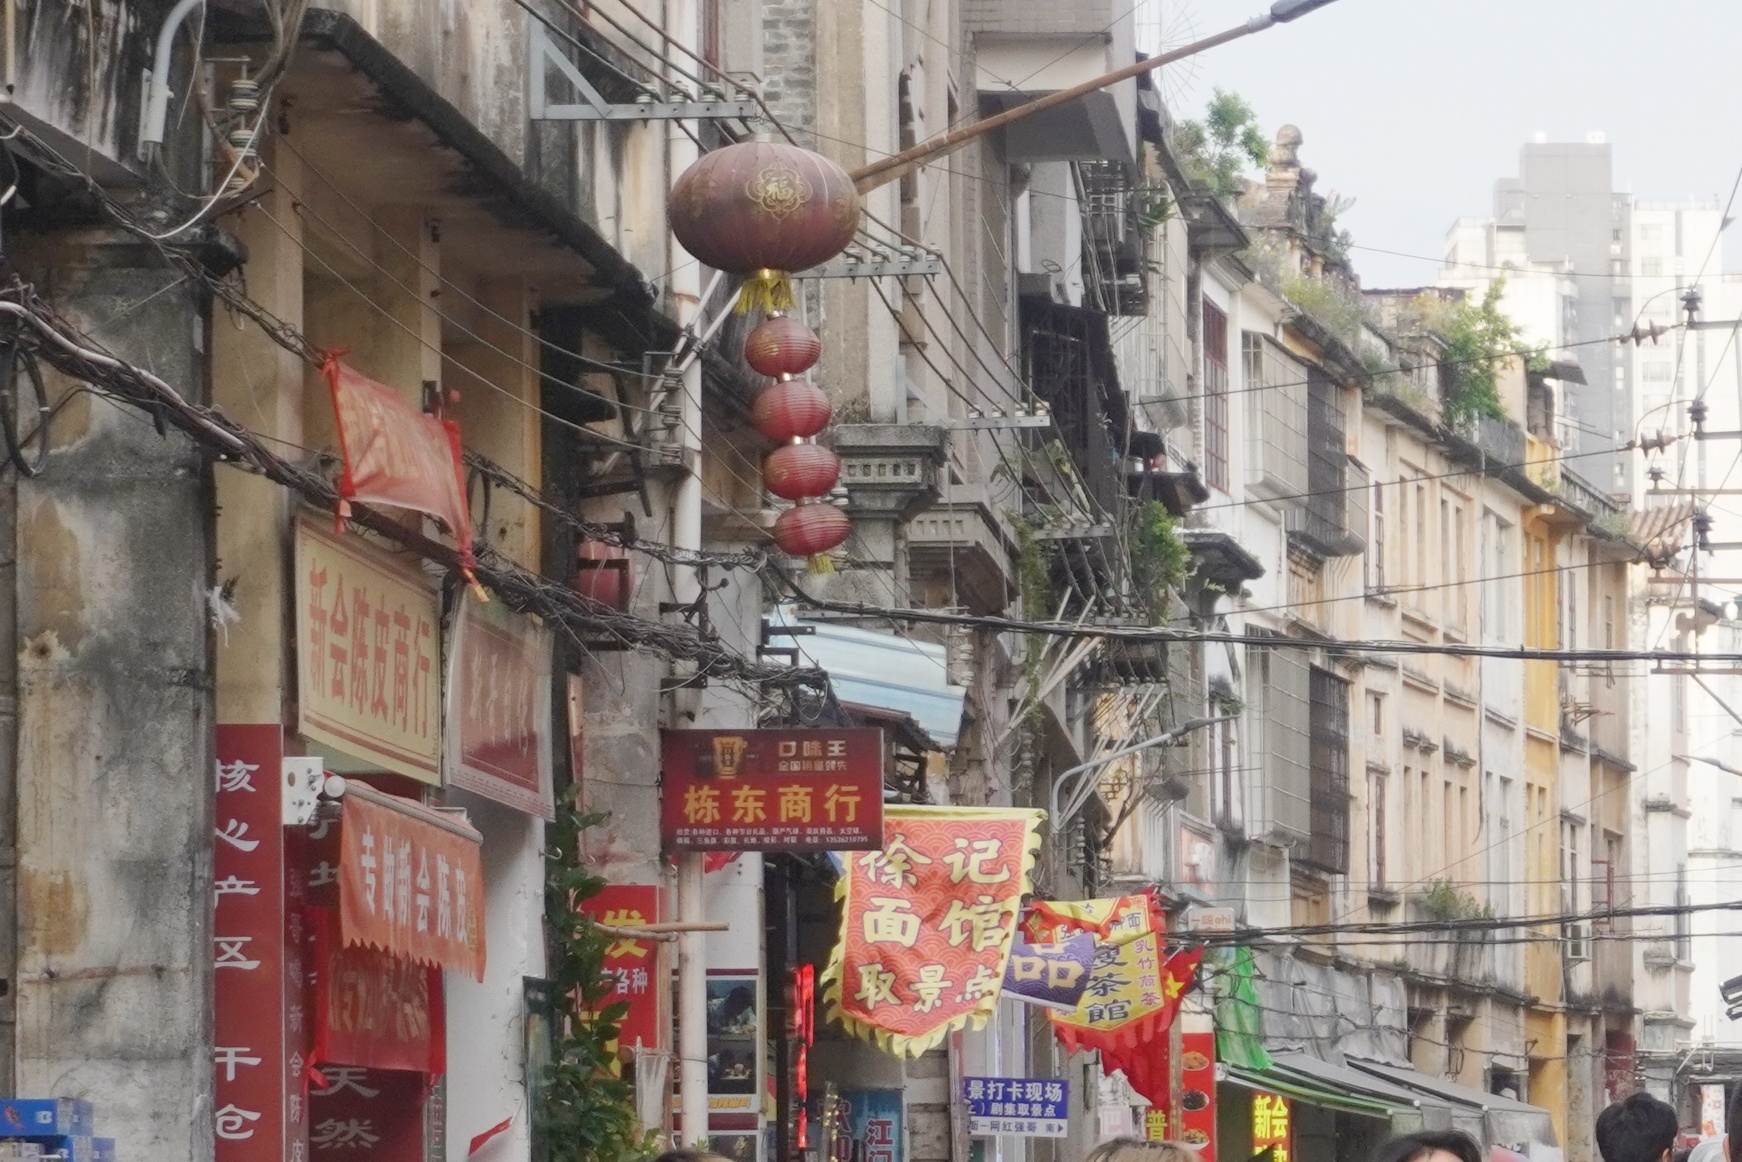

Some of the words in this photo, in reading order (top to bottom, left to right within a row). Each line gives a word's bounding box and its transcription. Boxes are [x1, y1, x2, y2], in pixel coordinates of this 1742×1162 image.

[766, 176, 793, 201] 福
[309, 557, 431, 739] 新会陈皮商行
[778, 740, 847, 758] 口味王
[683, 784, 861, 824] 栋东商行
[216, 759, 261, 970] 核心产区
[862, 895, 1014, 953] 面馆
[855, 964, 996, 1014] 取景点
[963, 1080, 1063, 1102] 景打卡现场
[1254, 1095, 1289, 1139] 新会
